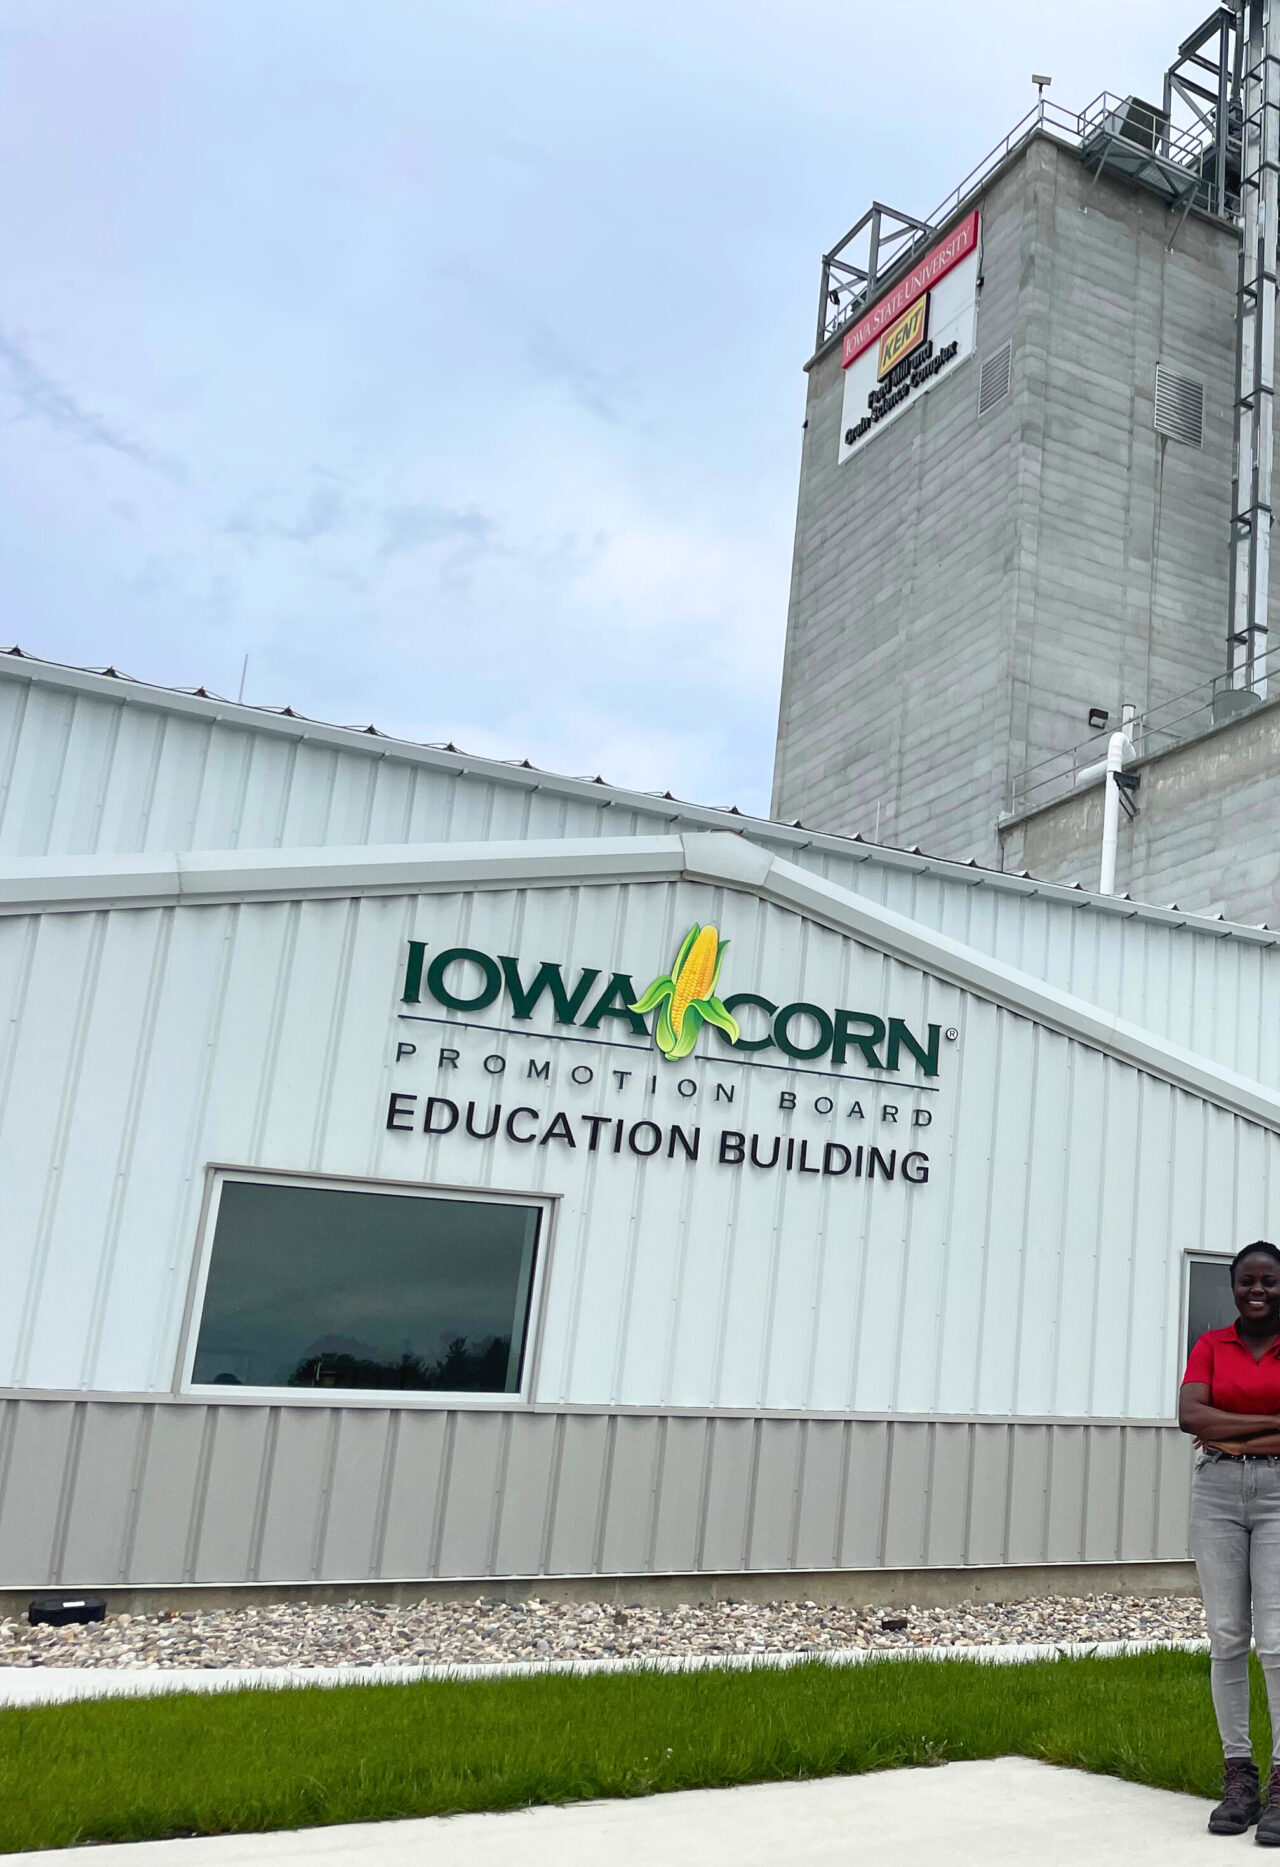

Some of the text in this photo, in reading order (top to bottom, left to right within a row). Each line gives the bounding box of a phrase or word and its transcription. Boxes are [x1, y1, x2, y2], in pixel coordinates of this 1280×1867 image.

[845, 226, 970, 357] IOWA STATE UNIVERSITY
[882, 309, 921, 367] KENT
[400, 940, 652, 1036] IOWA
[395, 1042, 933, 1128] PROMOTION BOARD
[386, 1092, 930, 1184] EDUCATION BUILDING
